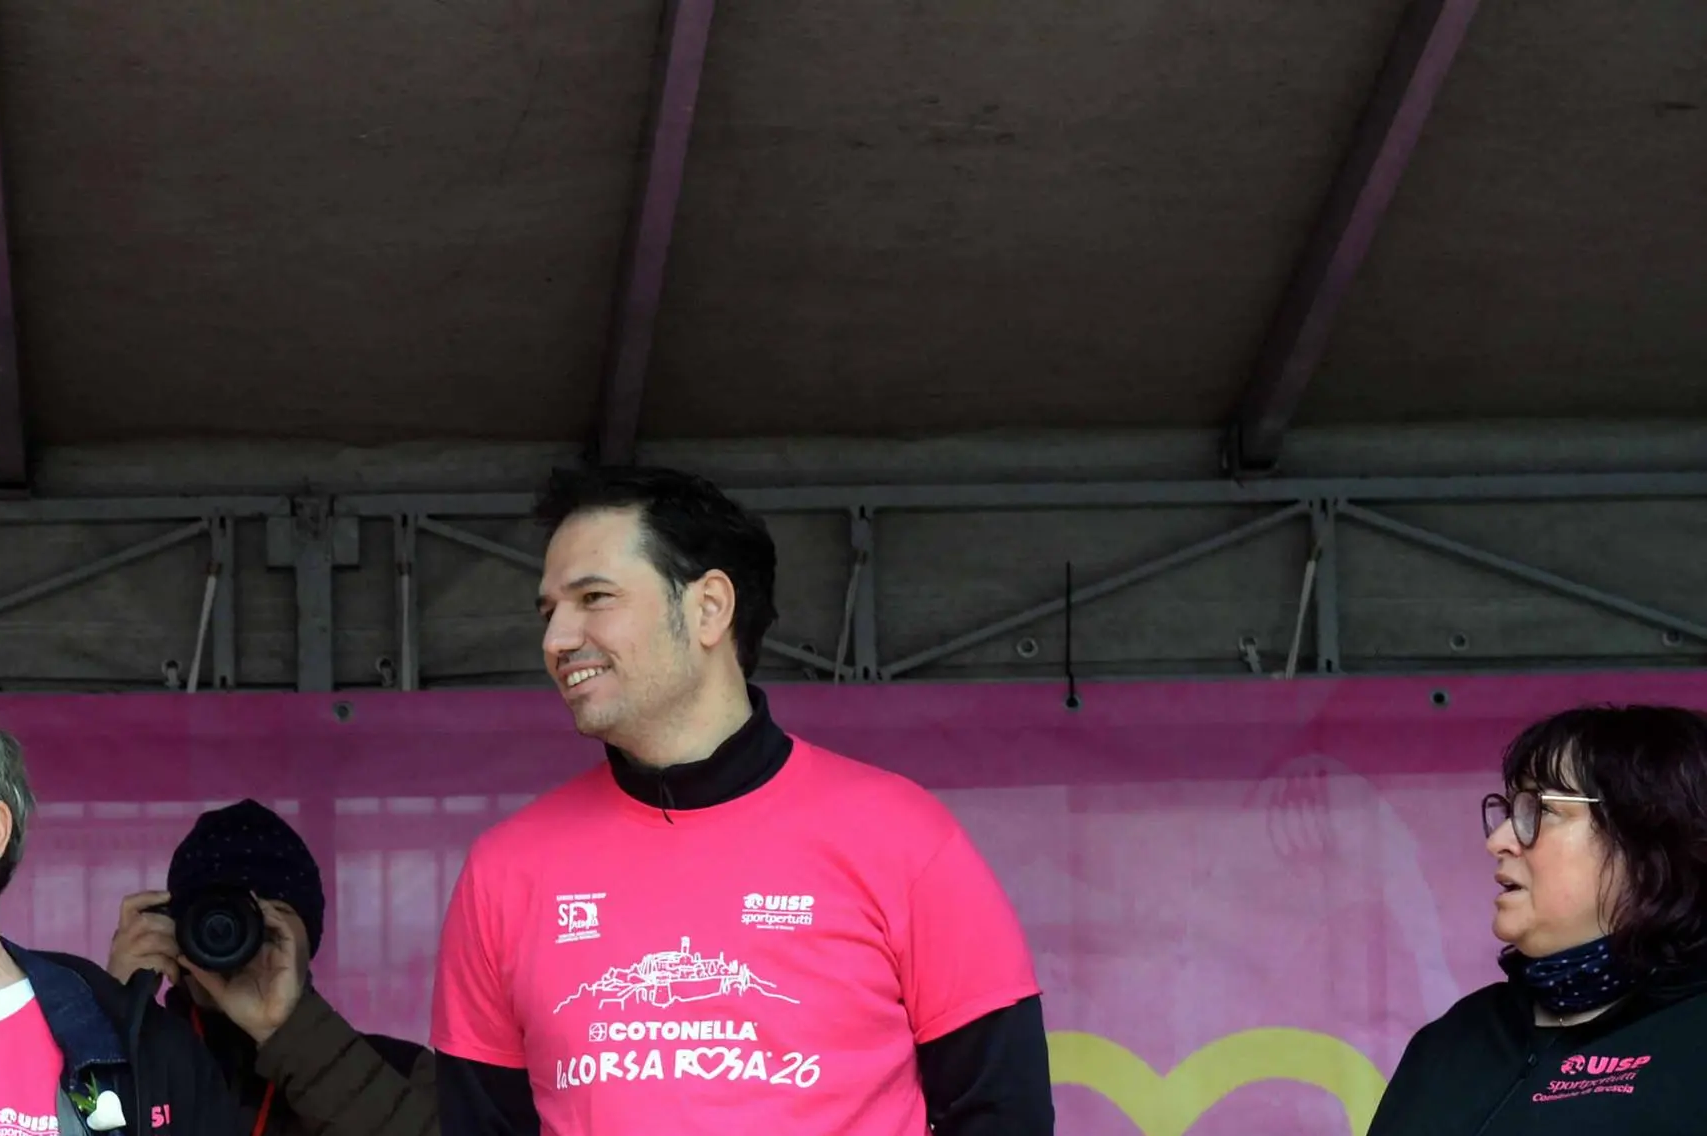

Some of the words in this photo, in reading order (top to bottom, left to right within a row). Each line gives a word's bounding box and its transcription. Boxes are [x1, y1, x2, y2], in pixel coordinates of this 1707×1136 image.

[765, 895, 815, 911] UISP
[608, 1020, 758, 1041] COTONELLA
[770, 1051, 821, 1088] 26
[1587, 1055, 1652, 1075] UISP
